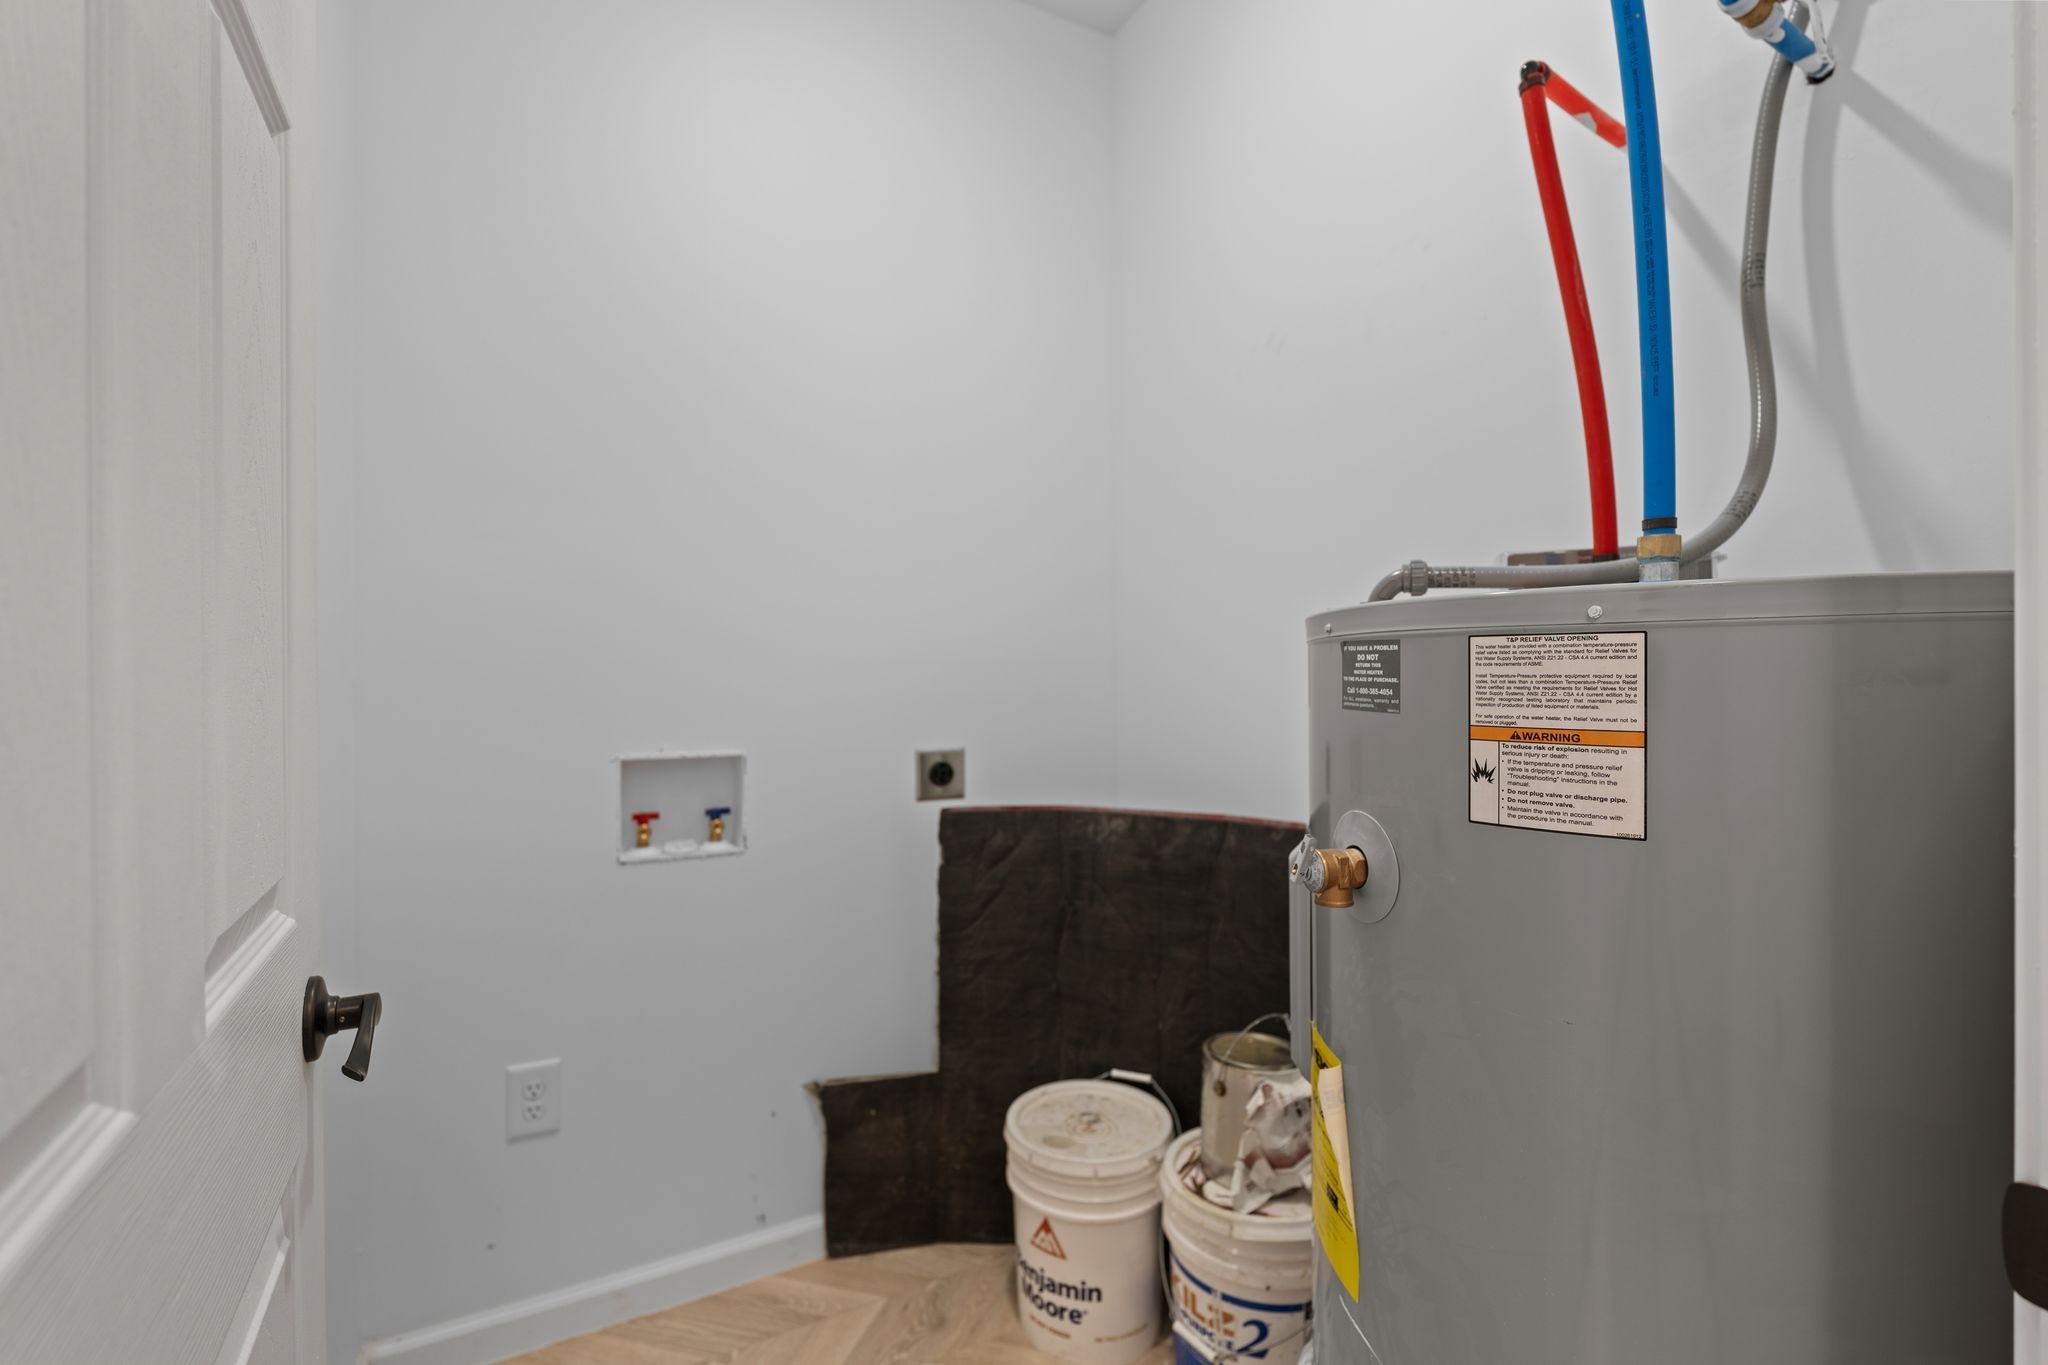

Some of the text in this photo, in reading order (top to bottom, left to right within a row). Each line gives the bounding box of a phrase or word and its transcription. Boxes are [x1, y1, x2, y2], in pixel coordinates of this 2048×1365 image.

[1522, 733, 1580, 742] WARNING
[1574, 795, 1608, 803] discharge
[1518, 814, 1548, 822] procedure
[1018, 1254, 1103, 1303] enjamin
[1236, 1318, 1273, 1360] 2
